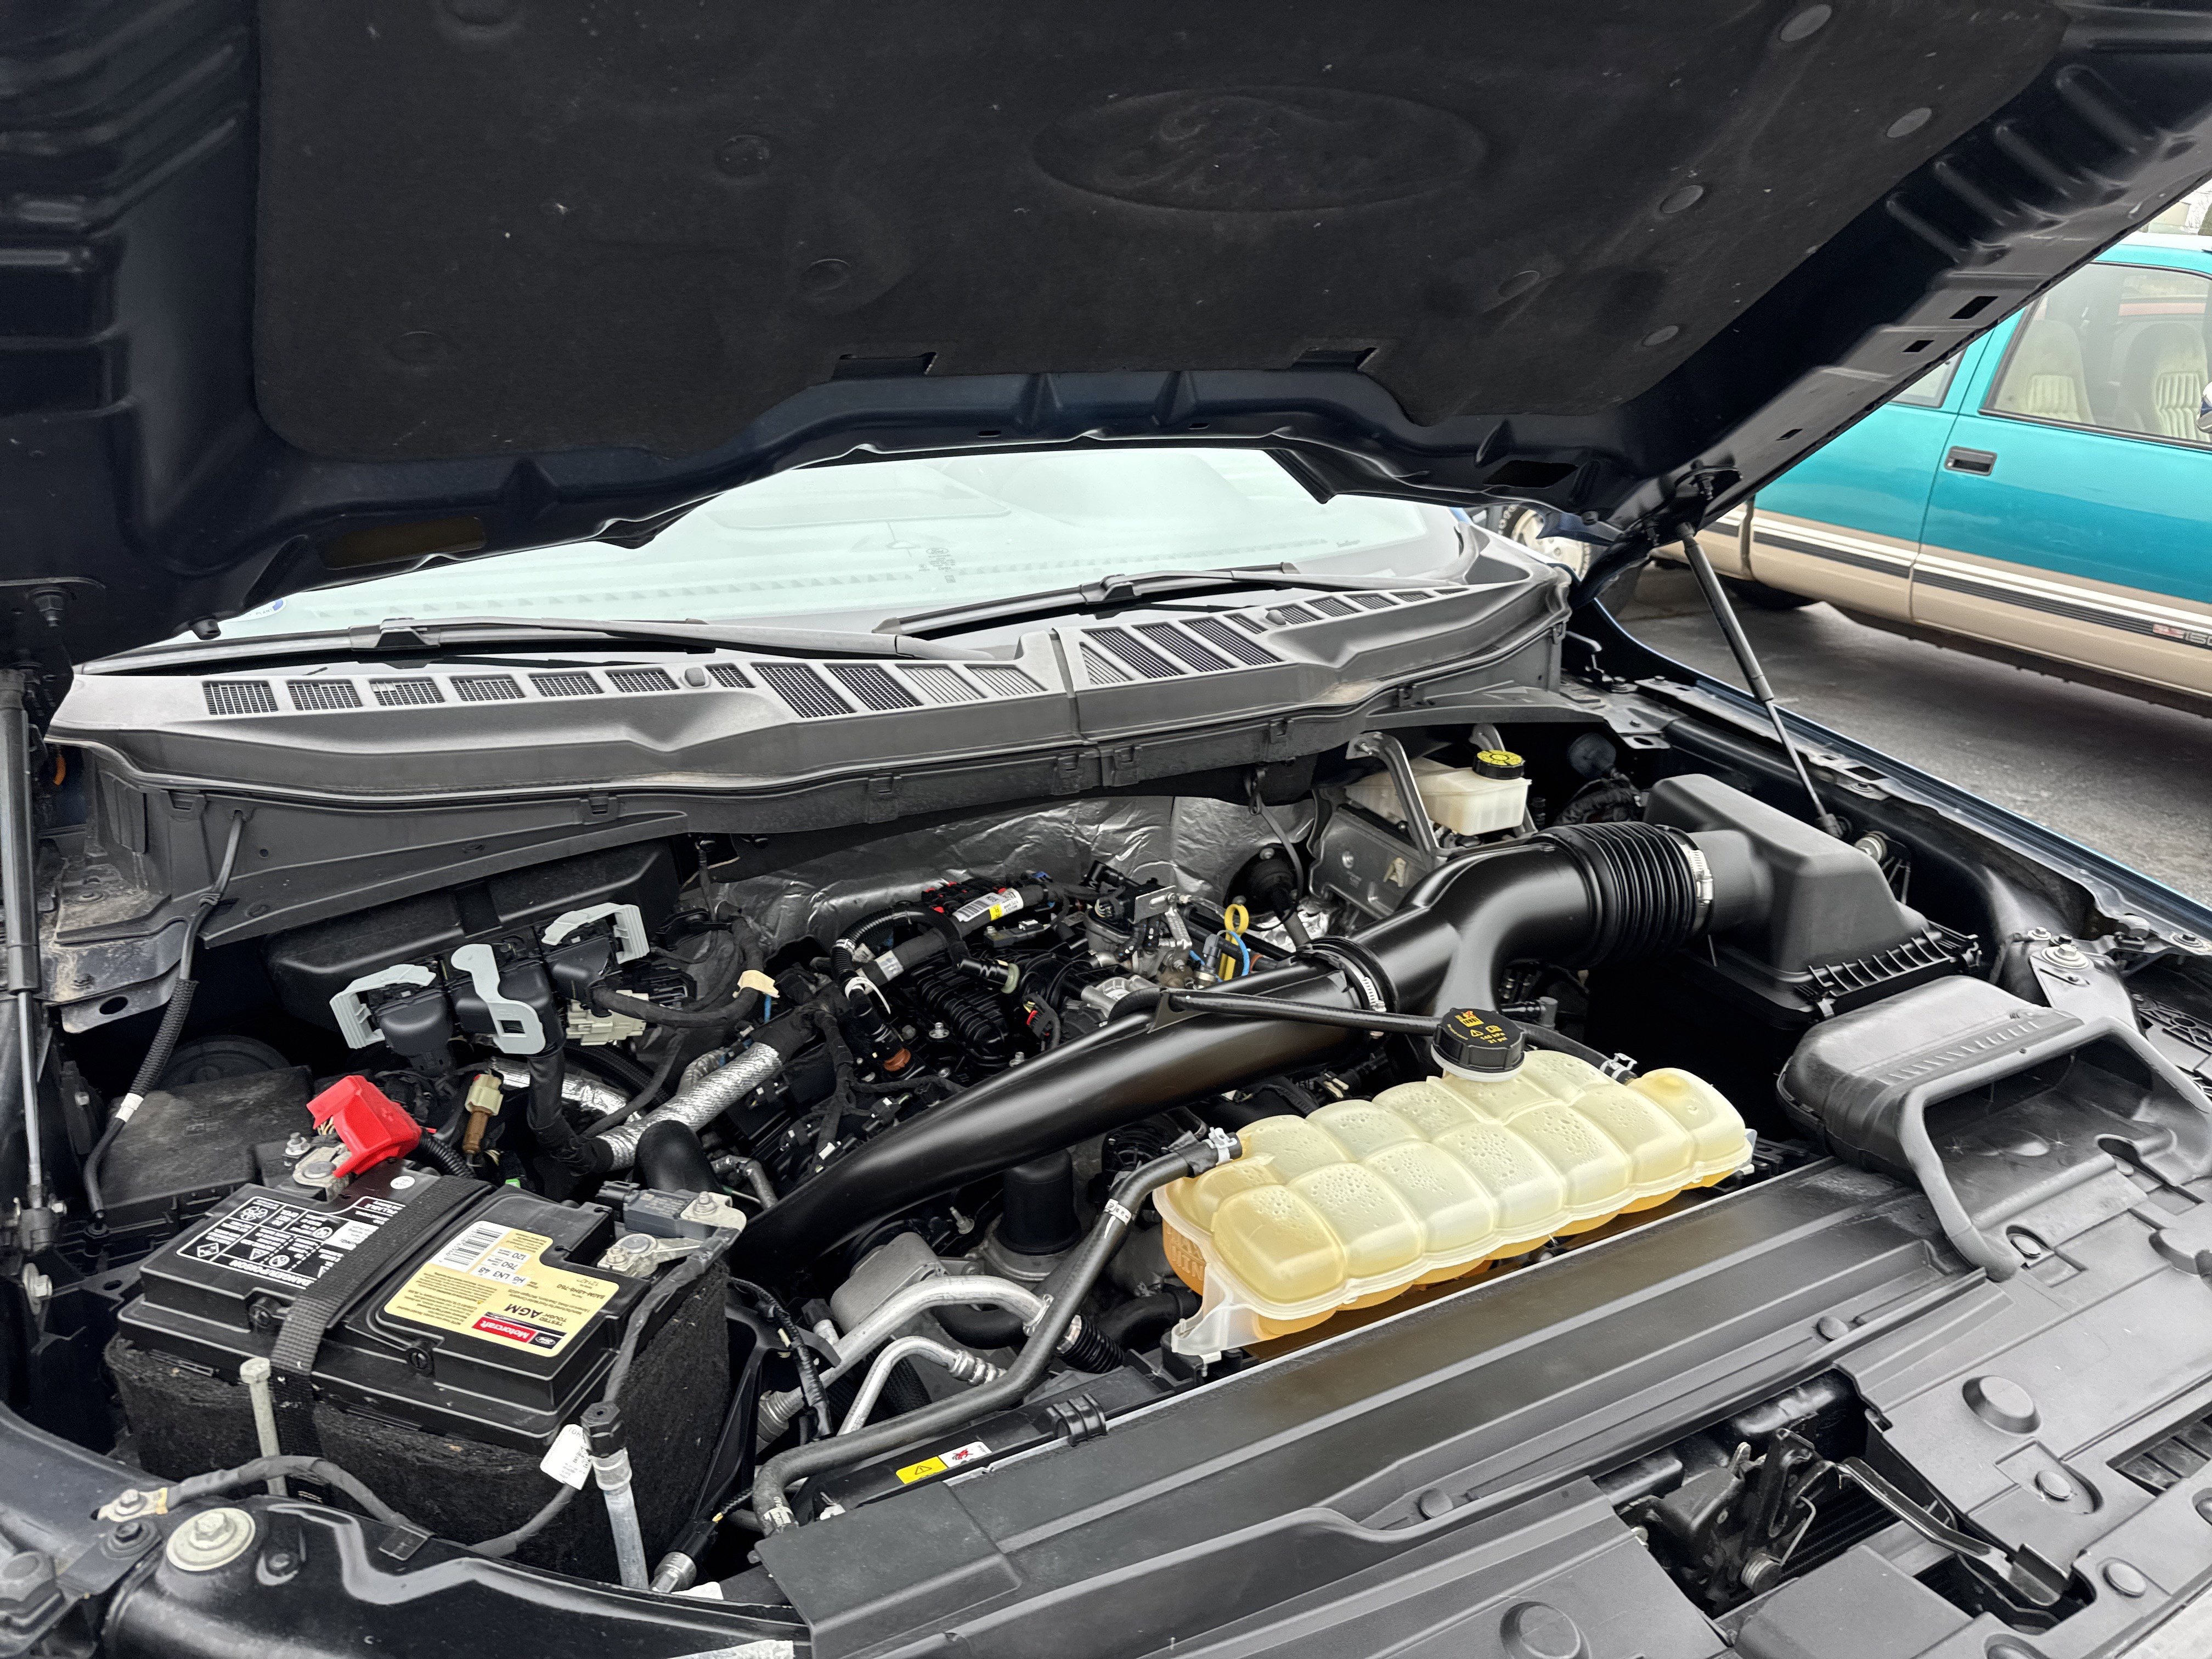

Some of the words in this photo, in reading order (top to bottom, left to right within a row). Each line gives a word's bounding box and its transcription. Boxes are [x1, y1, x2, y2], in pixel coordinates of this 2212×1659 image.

[2185, 630, 2212, 646] 15
[501, 1261, 518, 1270] 760
[493, 1271, 511, 1279] LN3
[504, 1304, 544, 1319] AGM
[539, 1317, 563, 1327] TESTED
[479, 1320, 531, 1339] Motorcraft
